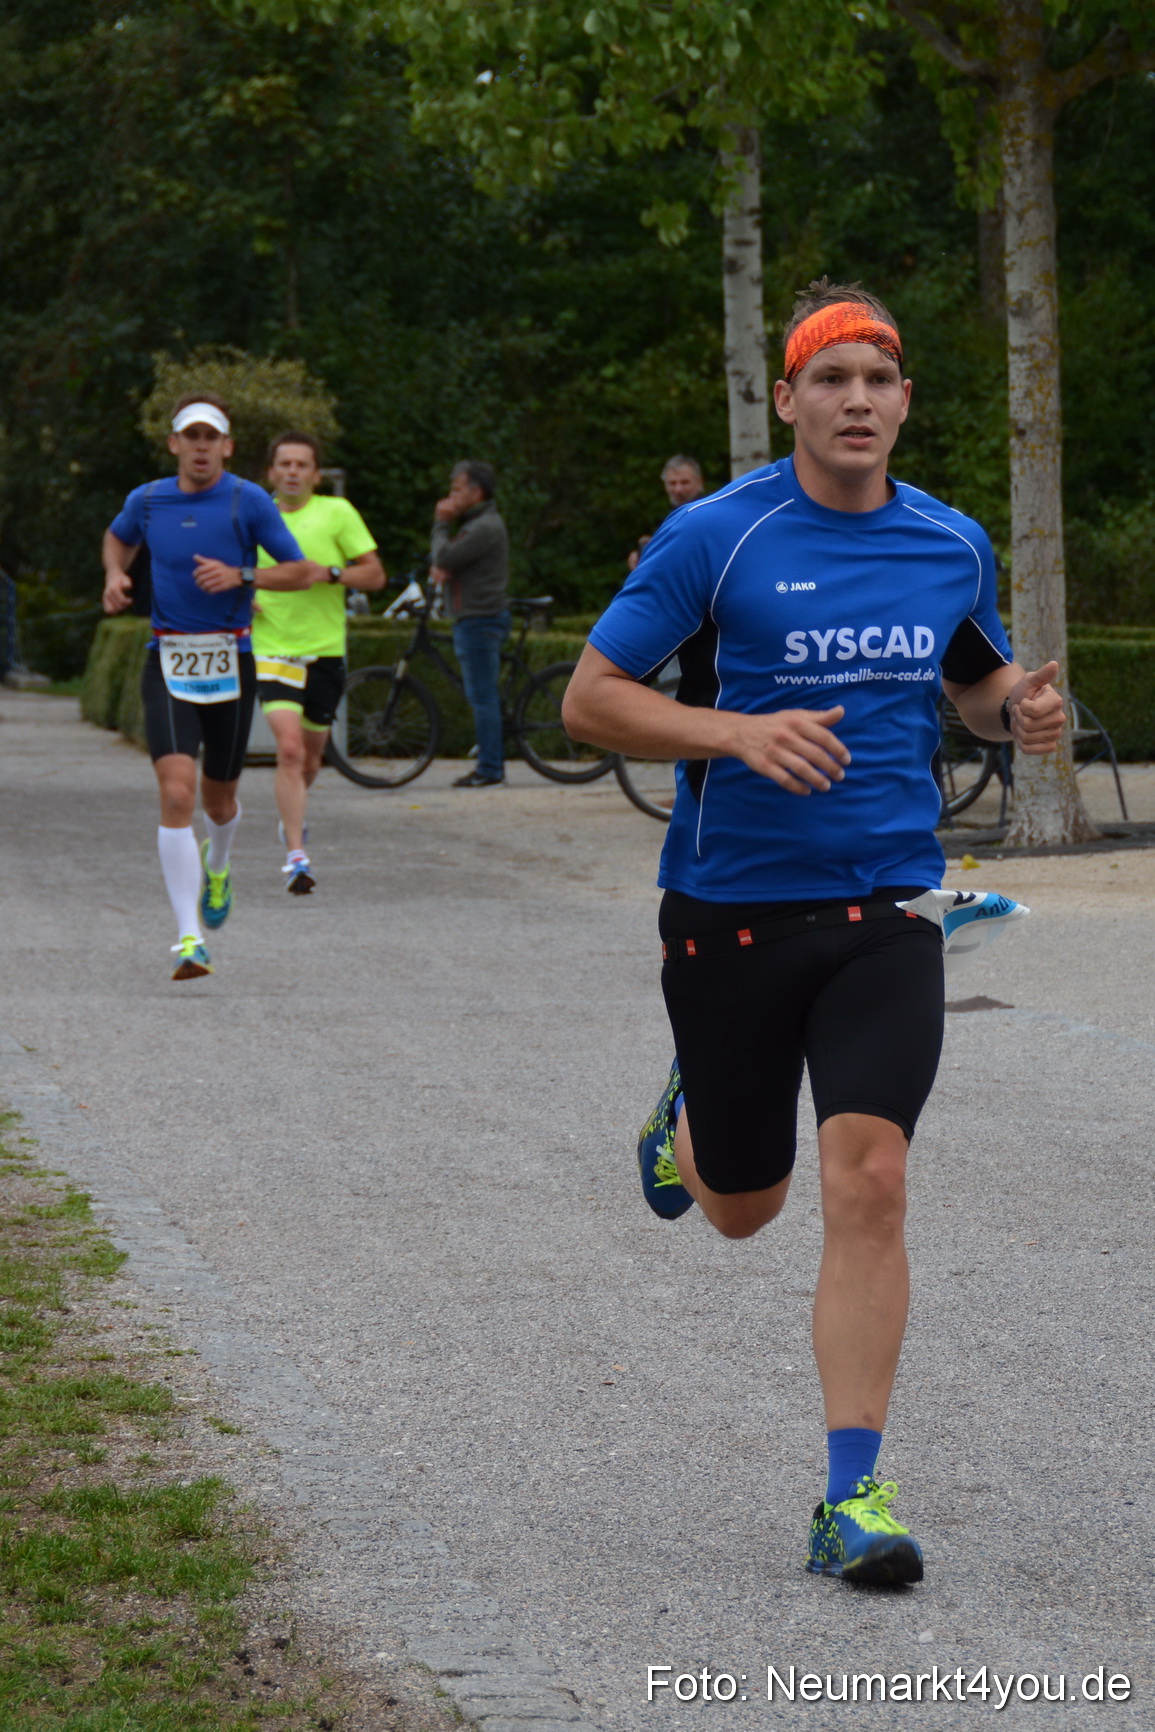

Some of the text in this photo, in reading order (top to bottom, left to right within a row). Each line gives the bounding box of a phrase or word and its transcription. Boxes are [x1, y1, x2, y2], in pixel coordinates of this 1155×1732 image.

[790, 581, 817, 591] JAKO
[783, 625, 935, 664] SYSCAD
[170, 650, 230, 676] 2273
[773, 668, 936, 685] www.metallbau-cad.de
[183, 682, 220, 692] Thomas
